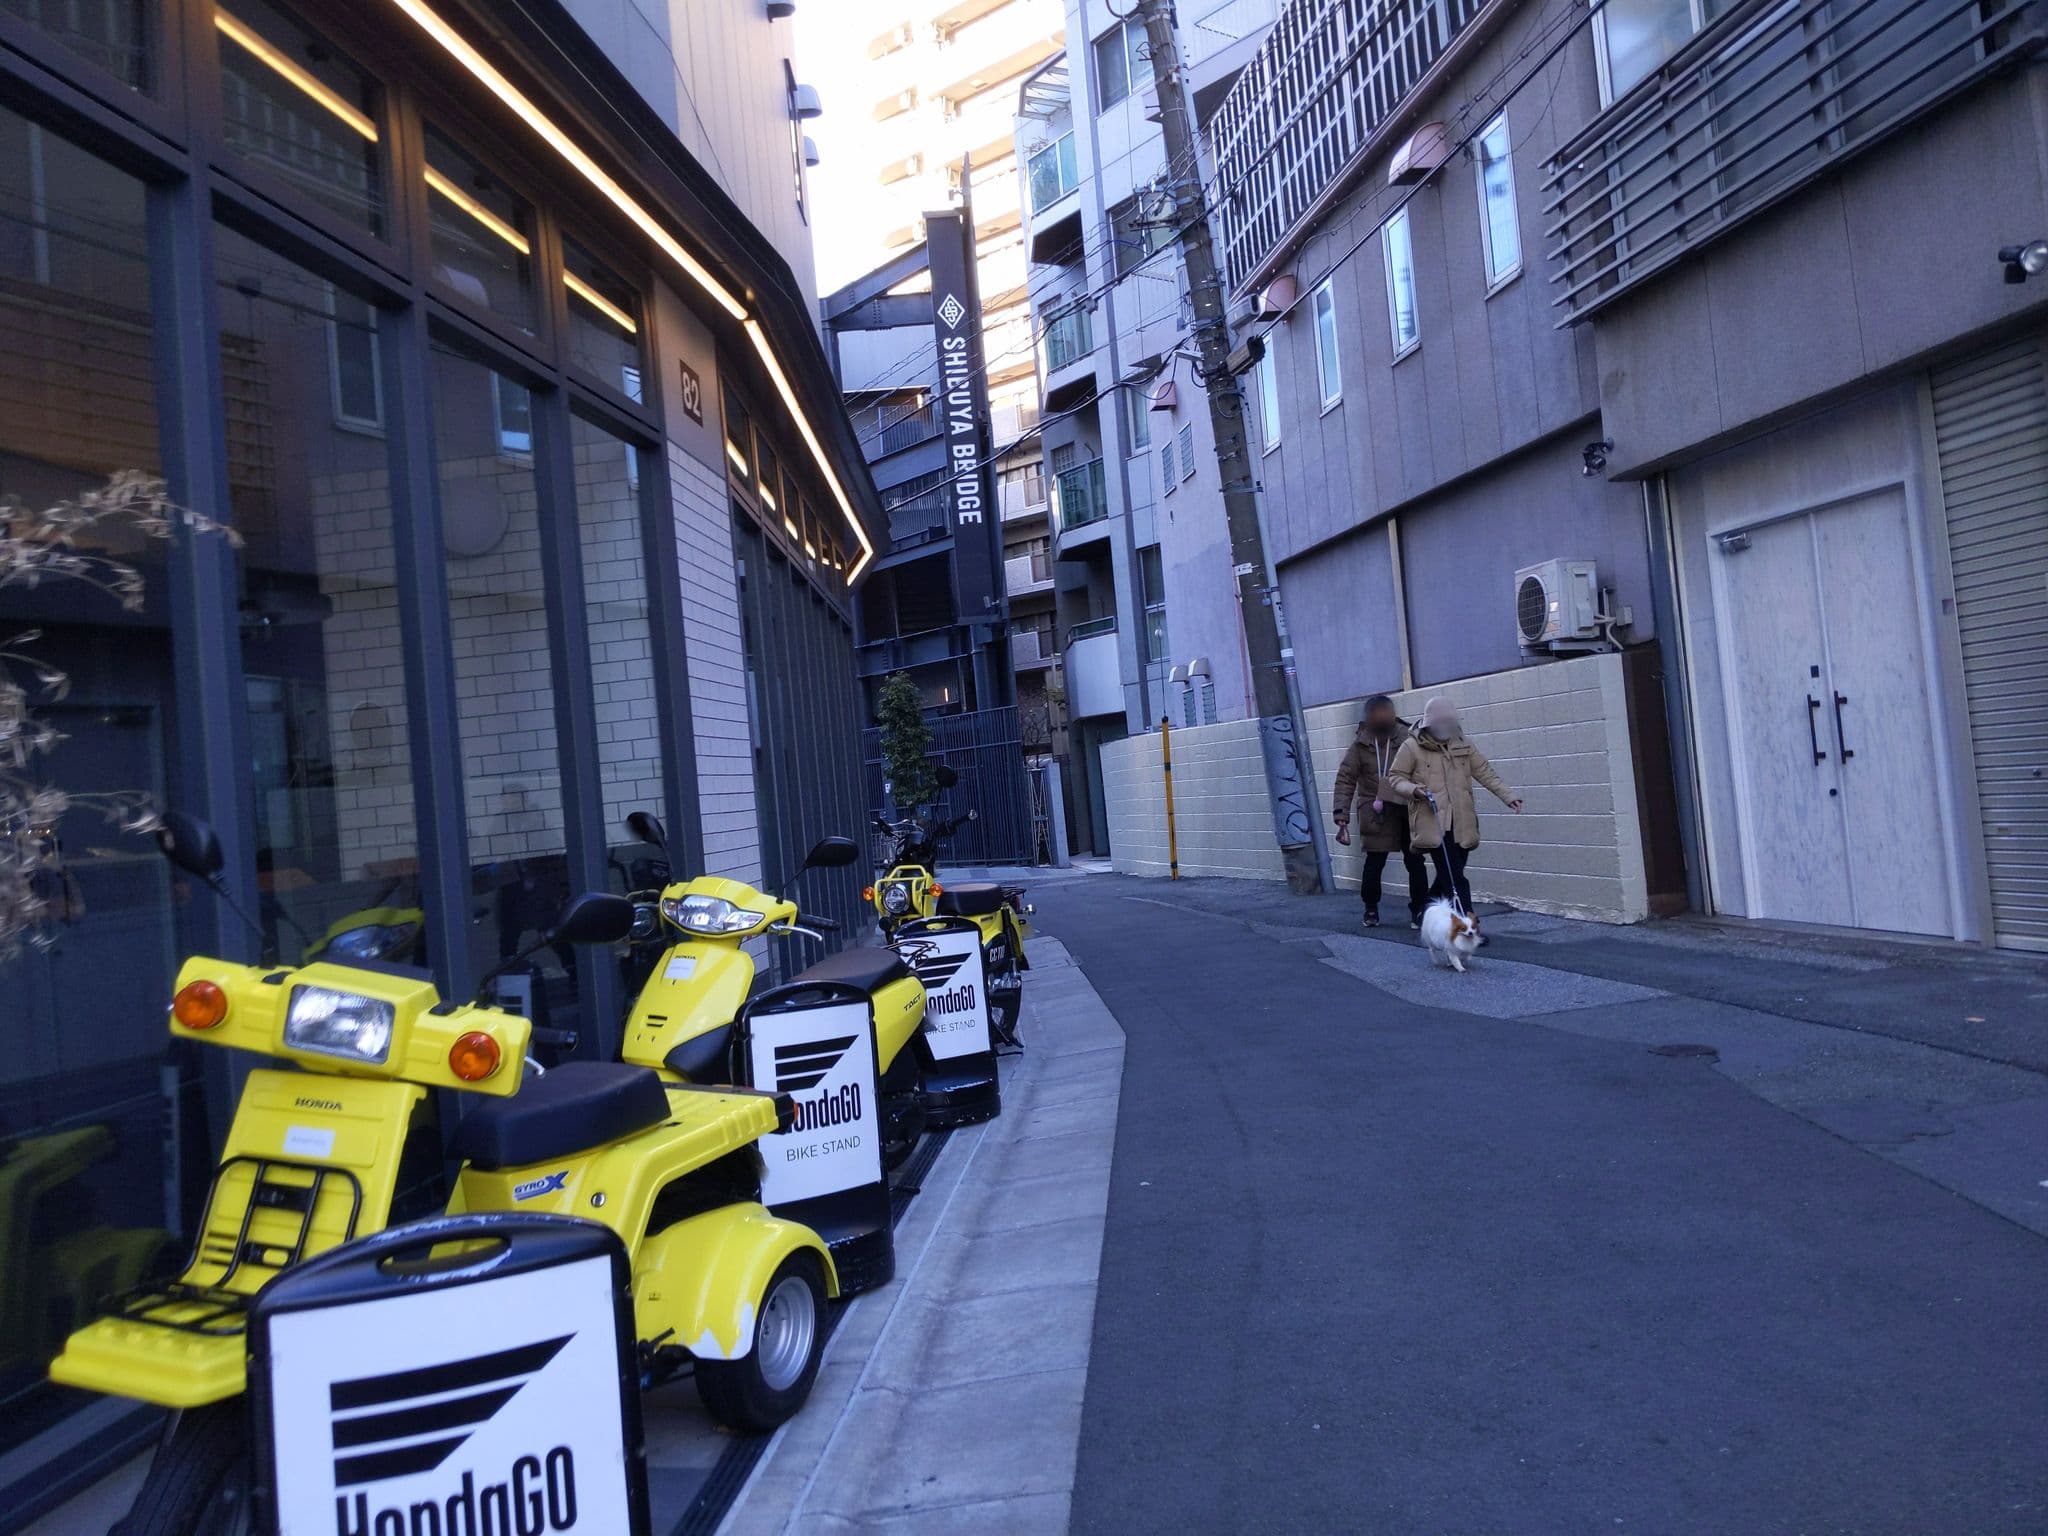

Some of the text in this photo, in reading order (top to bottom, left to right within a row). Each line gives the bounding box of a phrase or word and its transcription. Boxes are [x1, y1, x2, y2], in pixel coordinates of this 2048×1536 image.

[683, 371, 700, 416] 82
[943, 337, 973, 434] SHIBUYA
[953, 444, 982, 524] BRIDGE
[926, 984, 975, 1015] ondaGO
[295, 1097, 342, 1111] HONDA
[785, 1083, 861, 1133] ondaGO
[787, 1135, 861, 1161] BIKE STAND
